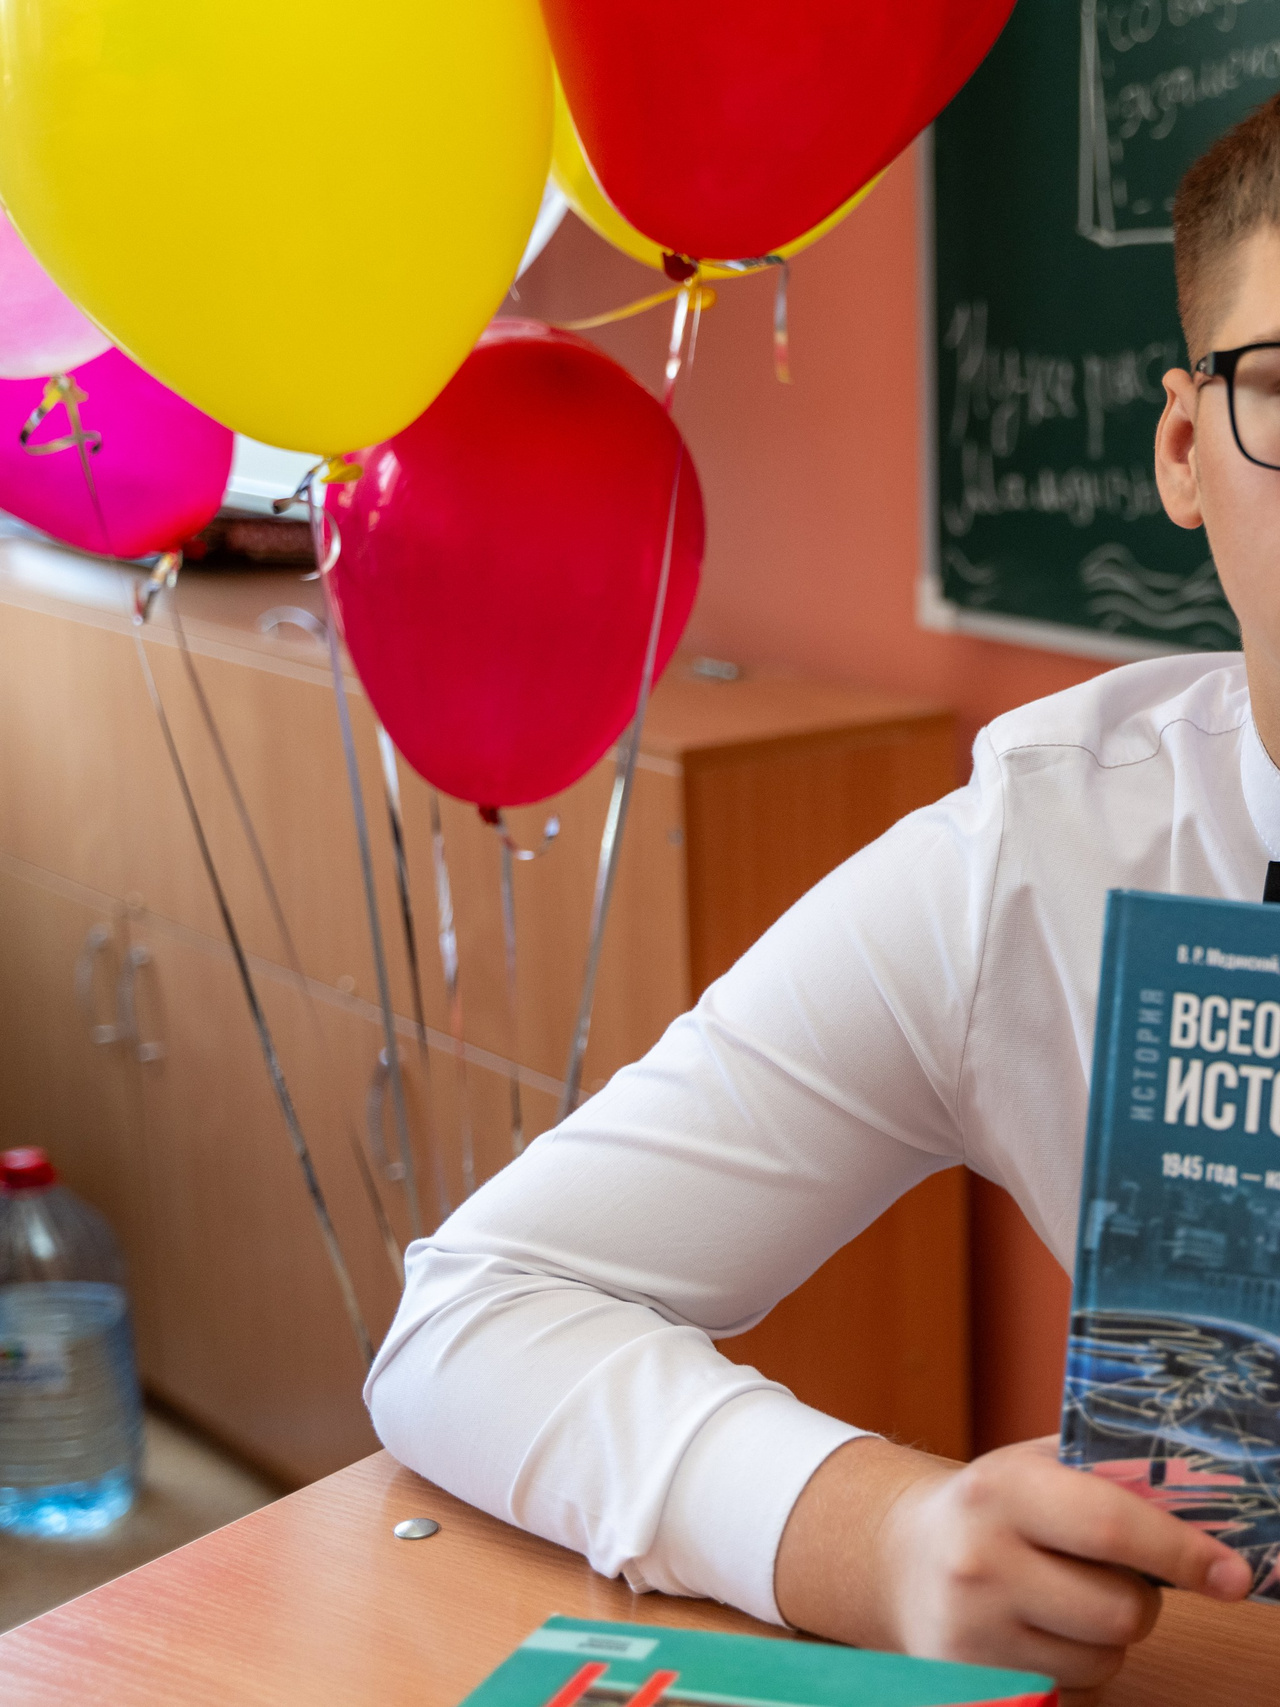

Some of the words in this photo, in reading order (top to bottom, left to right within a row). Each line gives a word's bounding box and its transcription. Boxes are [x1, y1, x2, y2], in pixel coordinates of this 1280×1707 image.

[1130, 987, 1164, 1122] ИСТОРИЯ
[1162, 1152, 1204, 1181] 1945
[1205, 1162, 1239, 1188] год
